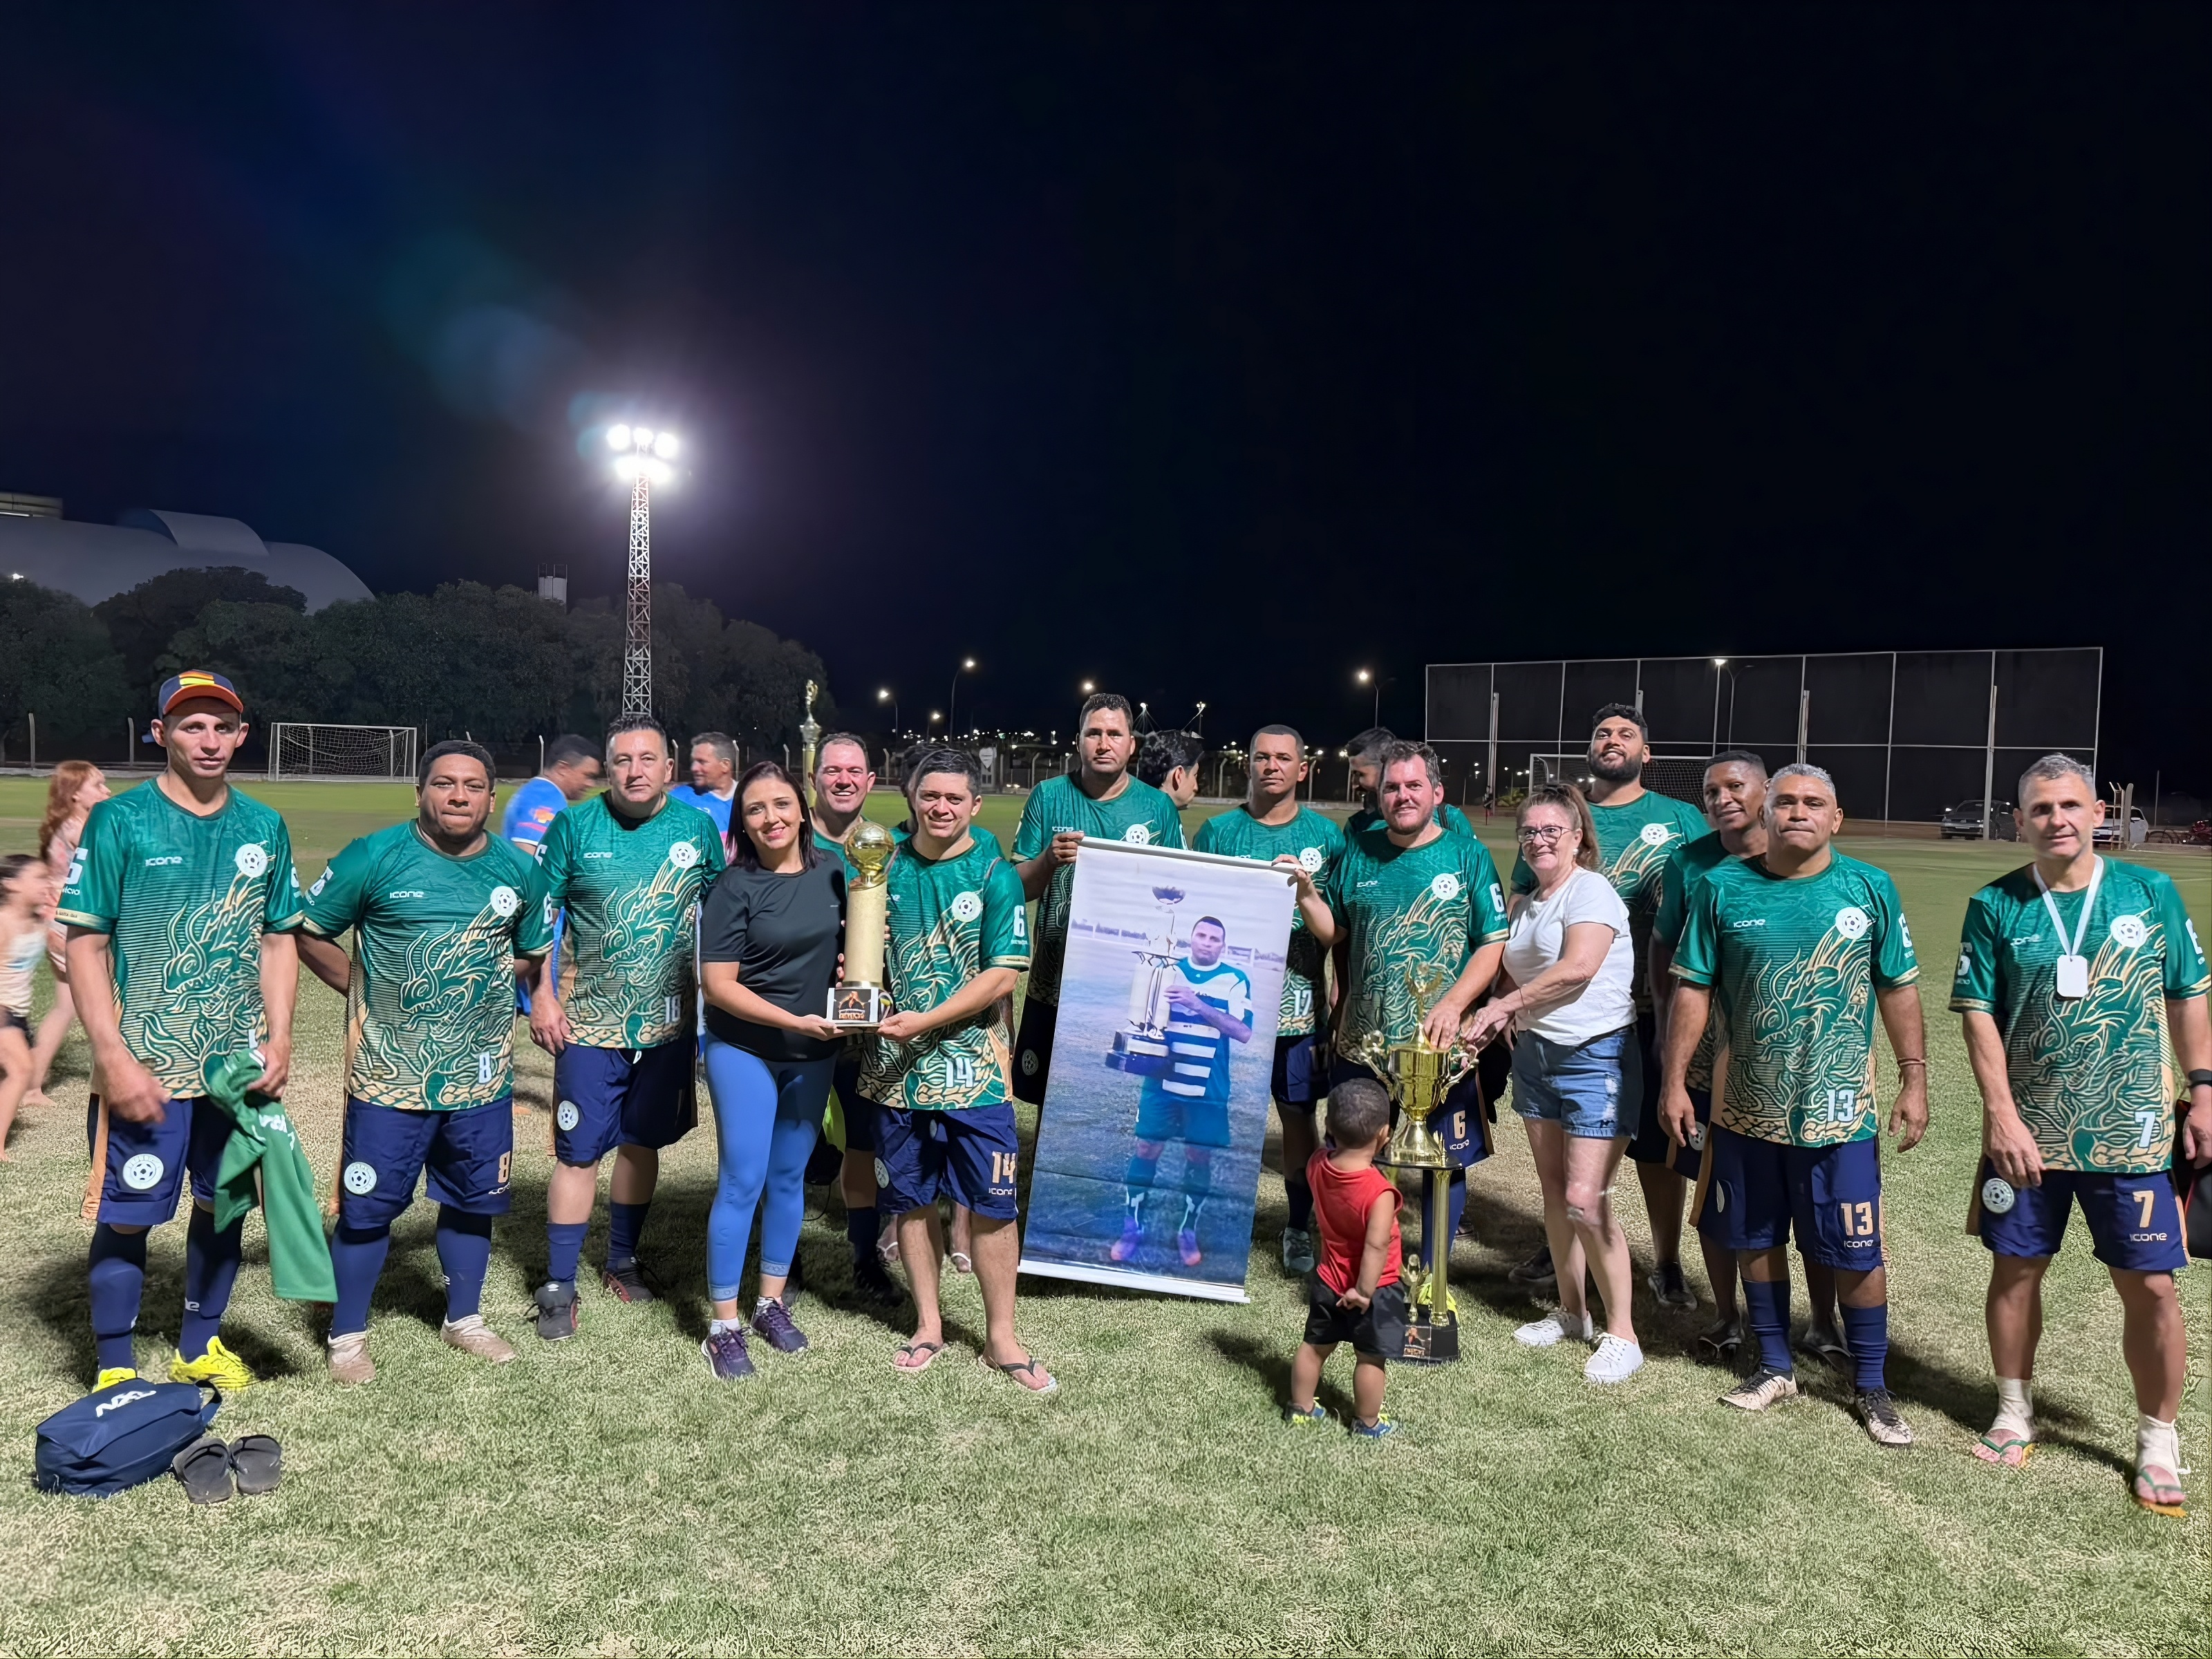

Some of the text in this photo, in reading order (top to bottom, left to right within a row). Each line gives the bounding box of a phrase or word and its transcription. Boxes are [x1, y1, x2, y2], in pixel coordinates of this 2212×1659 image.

[1489, 883, 1505, 913] 6
[1013, 905, 1025, 937] 6
[1293, 989, 1313, 1017] 17
[478, 1051, 492, 1083] 8
[944, 1057, 973, 1088] 14
[1826, 1089, 1855, 1122] 13
[1453, 1110, 1466, 1139] 6
[2135, 1111, 2156, 1147] 7
[498, 1150, 511, 1183] 8
[992, 1151, 1016, 1184] 14
[1840, 1201, 1873, 1236] 13
[2132, 1190, 2155, 1228] 7
